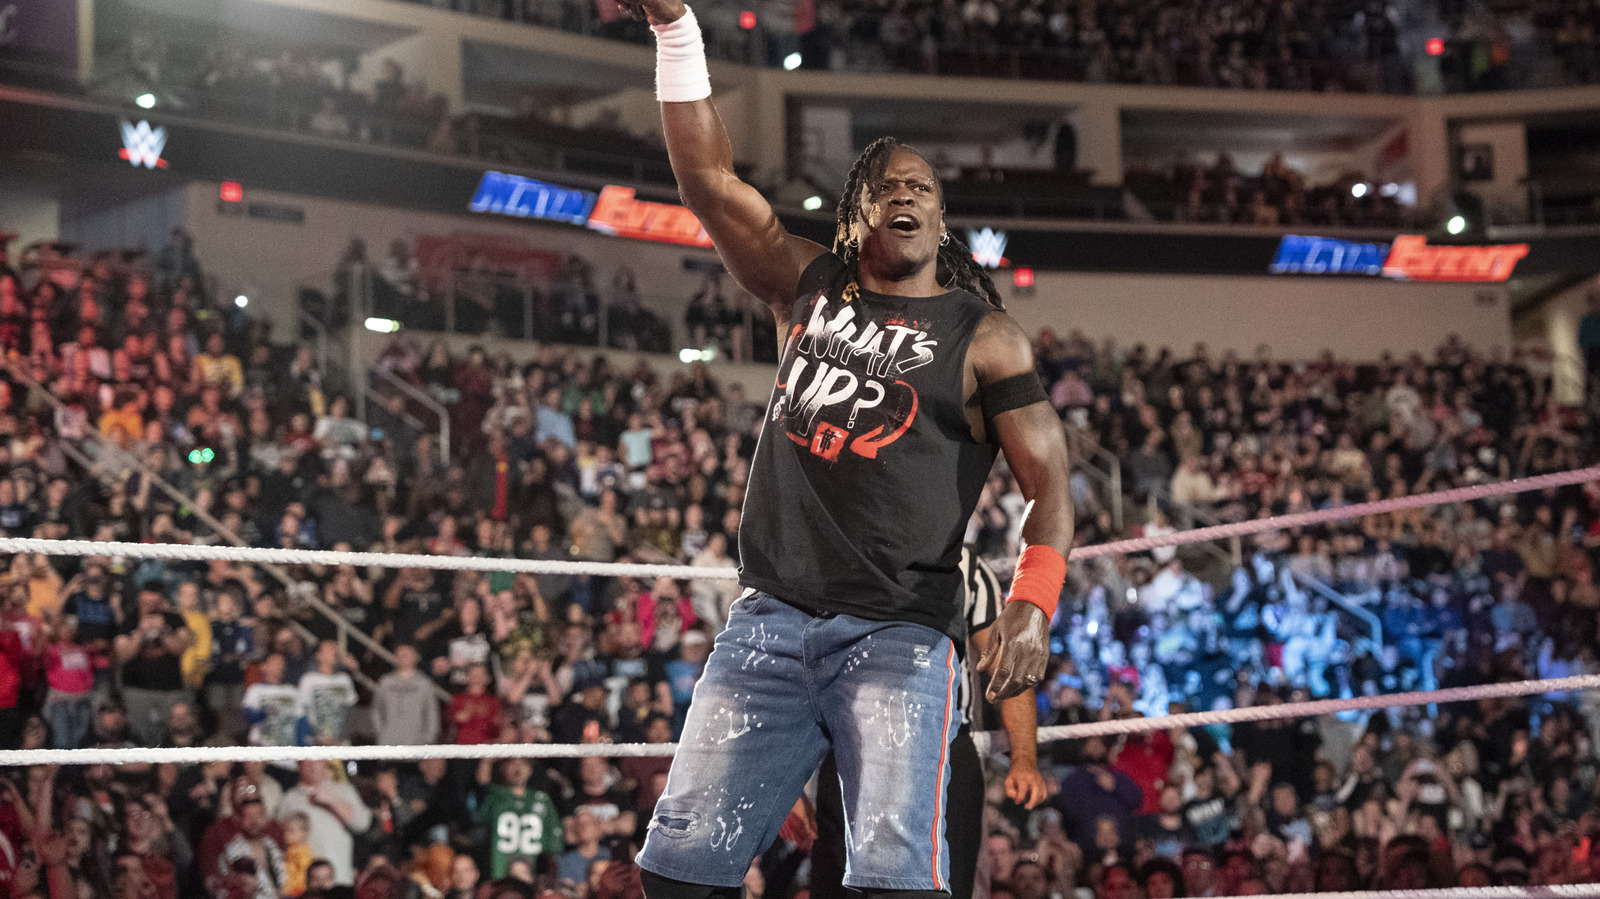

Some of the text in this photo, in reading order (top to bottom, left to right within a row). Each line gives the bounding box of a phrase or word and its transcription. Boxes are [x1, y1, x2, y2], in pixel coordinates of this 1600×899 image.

[1382, 234, 1530, 282] EVENT
[798, 294, 938, 378] WHAT'S
[786, 355, 886, 437] UP?
[497, 811, 543, 855] 92
